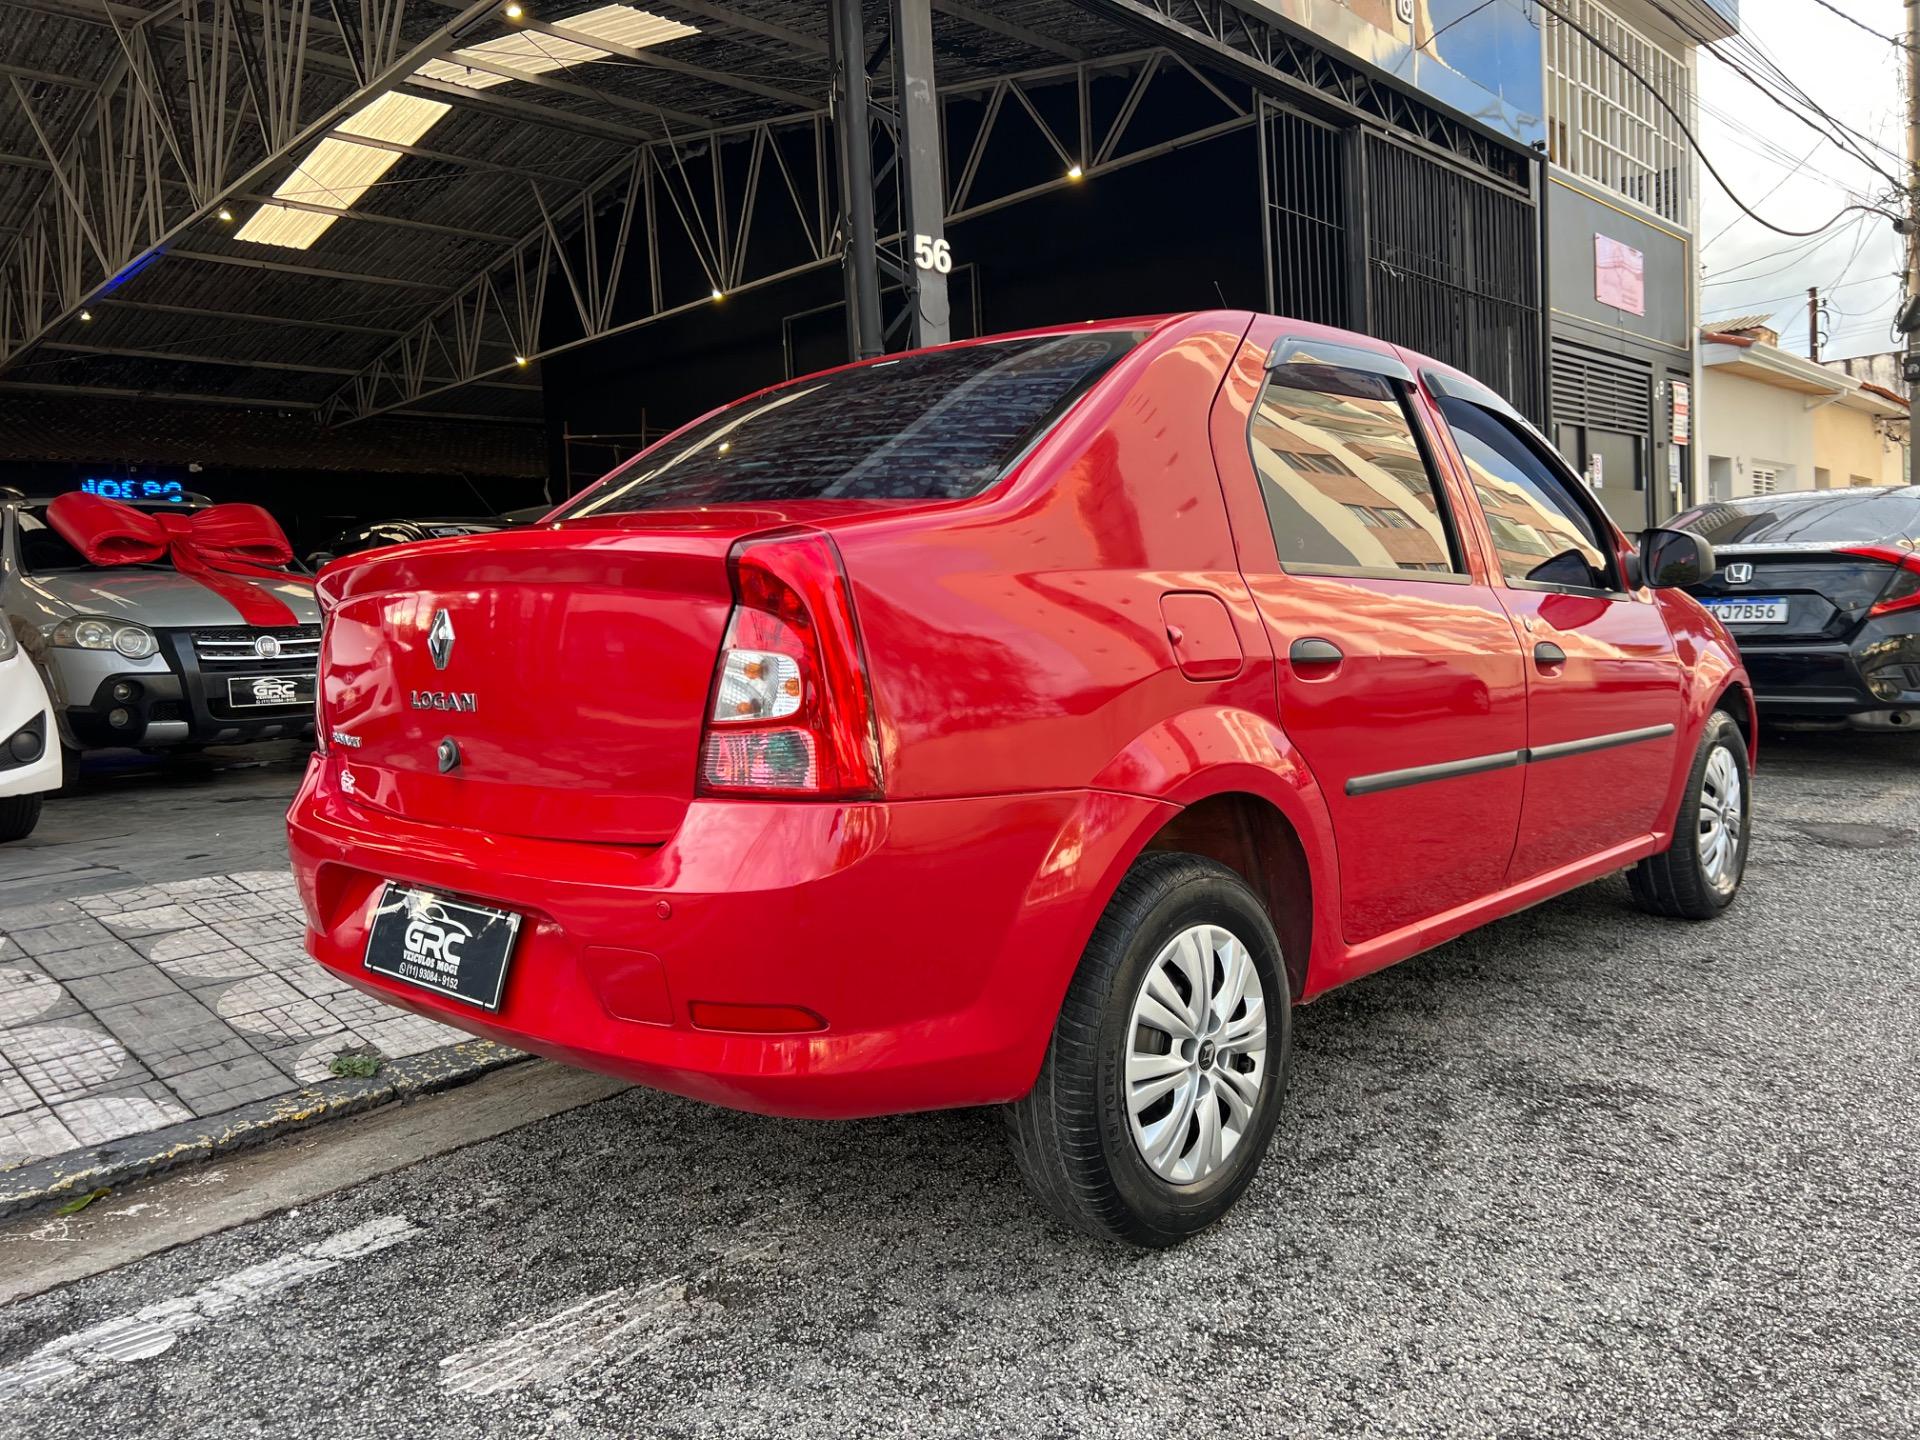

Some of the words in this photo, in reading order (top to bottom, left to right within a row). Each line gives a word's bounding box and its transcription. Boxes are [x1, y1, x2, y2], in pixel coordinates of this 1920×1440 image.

[914, 234, 952, 274] 56
[1705, 604, 1777, 619] KJ7B56
[253, 684, 295, 696] GRC
[411, 690, 478, 712] LOGAN
[405, 920, 466, 966] GRC
[403, 949, 436, 968] VEICULOS
[436, 960, 459, 976] MOGI
[406, 963, 419, 979] (11)
